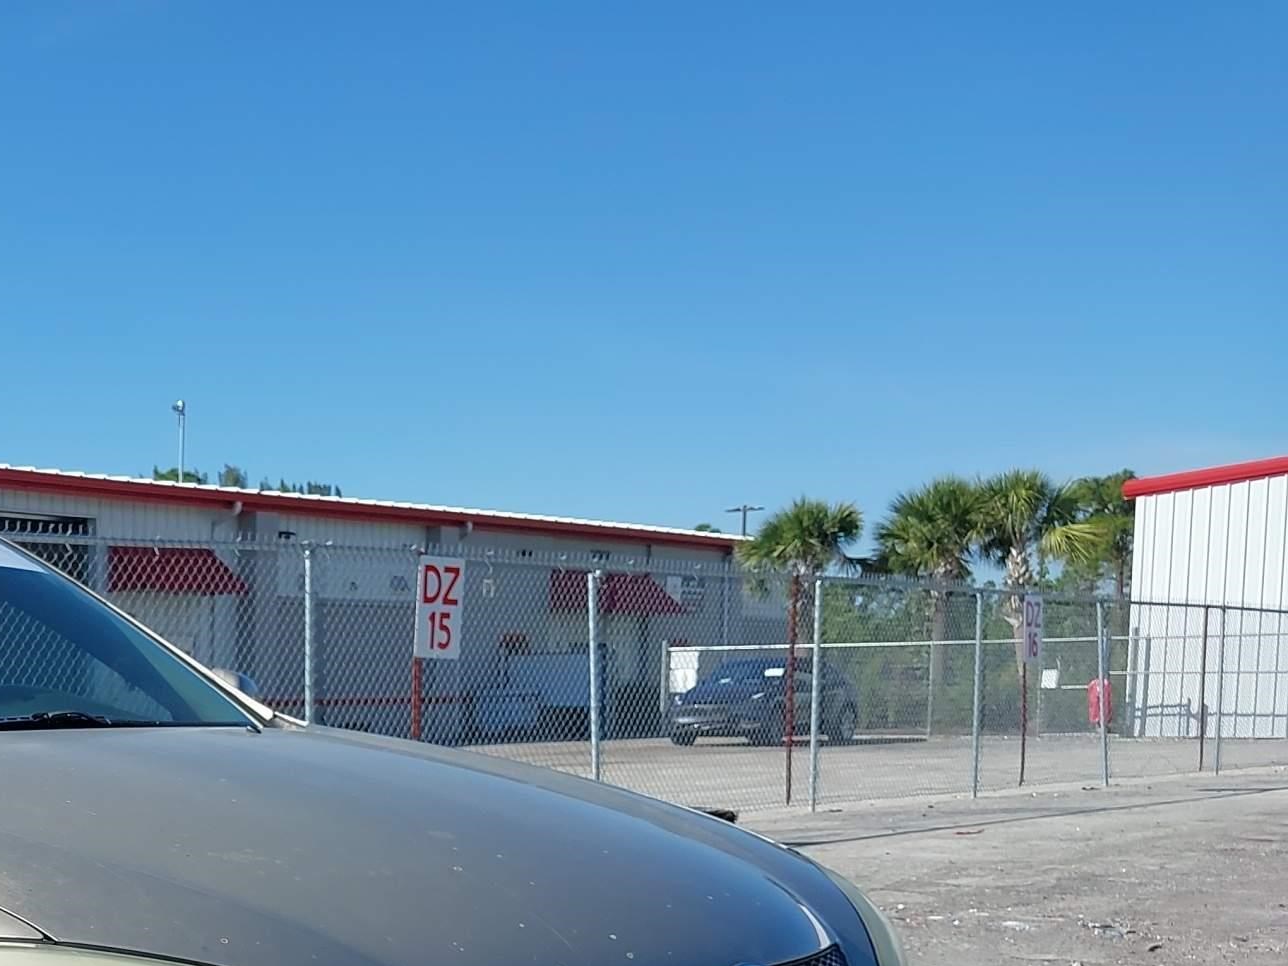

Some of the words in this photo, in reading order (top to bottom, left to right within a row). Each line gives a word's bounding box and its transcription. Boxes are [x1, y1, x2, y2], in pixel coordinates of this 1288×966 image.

[423, 564, 461, 606] DZ
[428, 611, 452, 651] 15
[1025, 600, 1042, 629] DZ
[1028, 631, 1039, 658] 16
